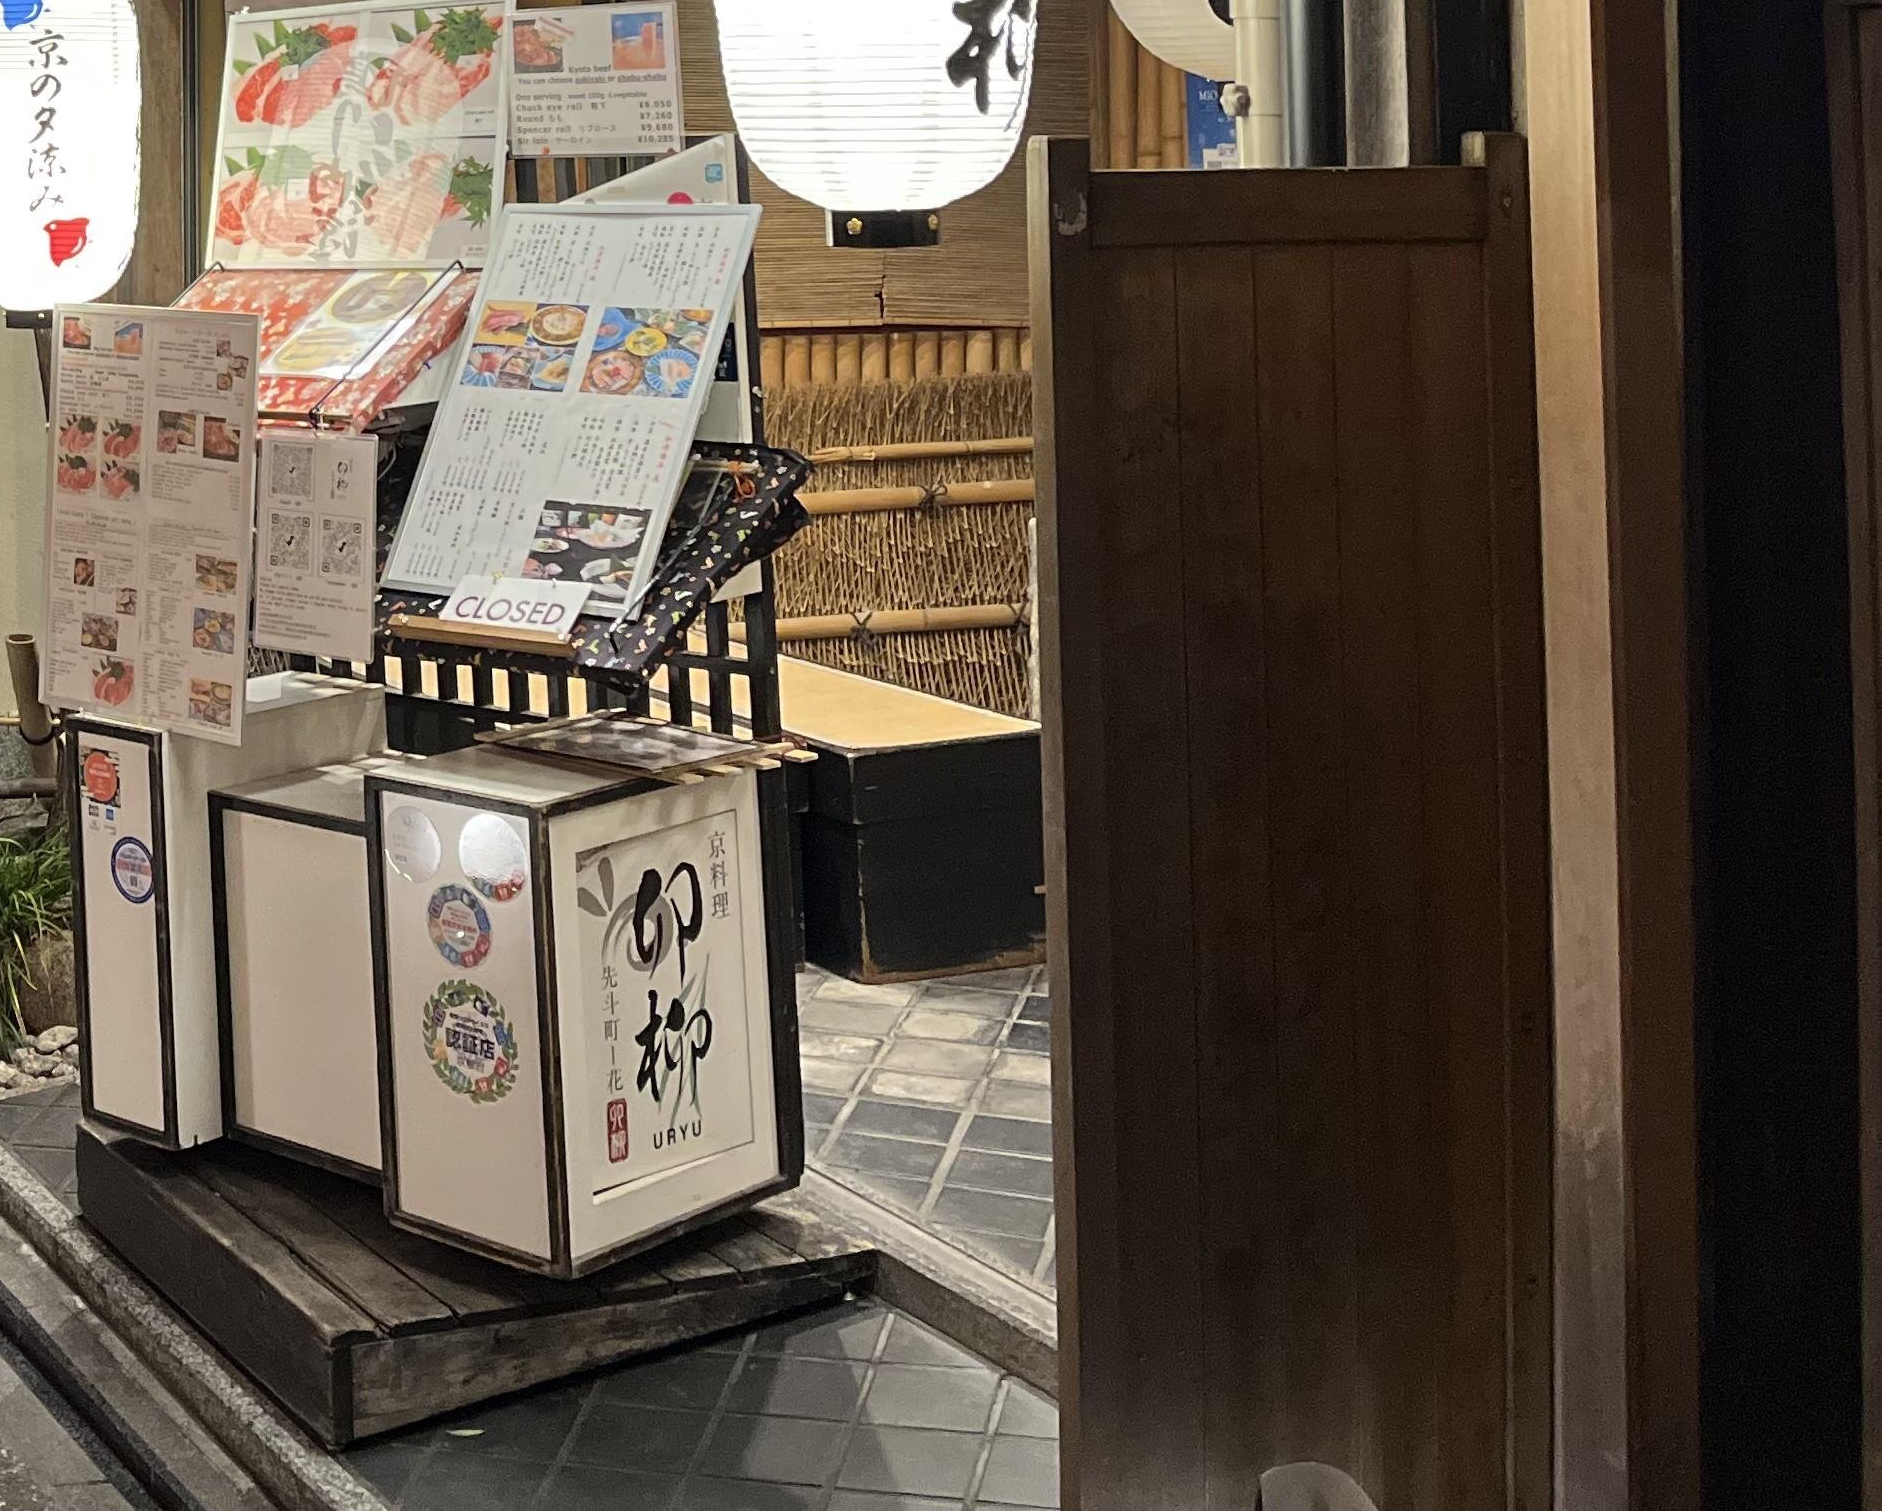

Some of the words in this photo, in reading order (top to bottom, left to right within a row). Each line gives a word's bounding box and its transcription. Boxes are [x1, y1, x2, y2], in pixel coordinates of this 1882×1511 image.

[28, 29, 68, 212] 京の夕涼み
[516, 103, 542, 112] Chuck
[547, 104, 562, 112] eye
[516, 115, 544, 123] Round
[454, 595, 566, 626] CLOSED
[707, 831, 731, 920] 京料理
[653, 1119, 702, 1150] URYU
